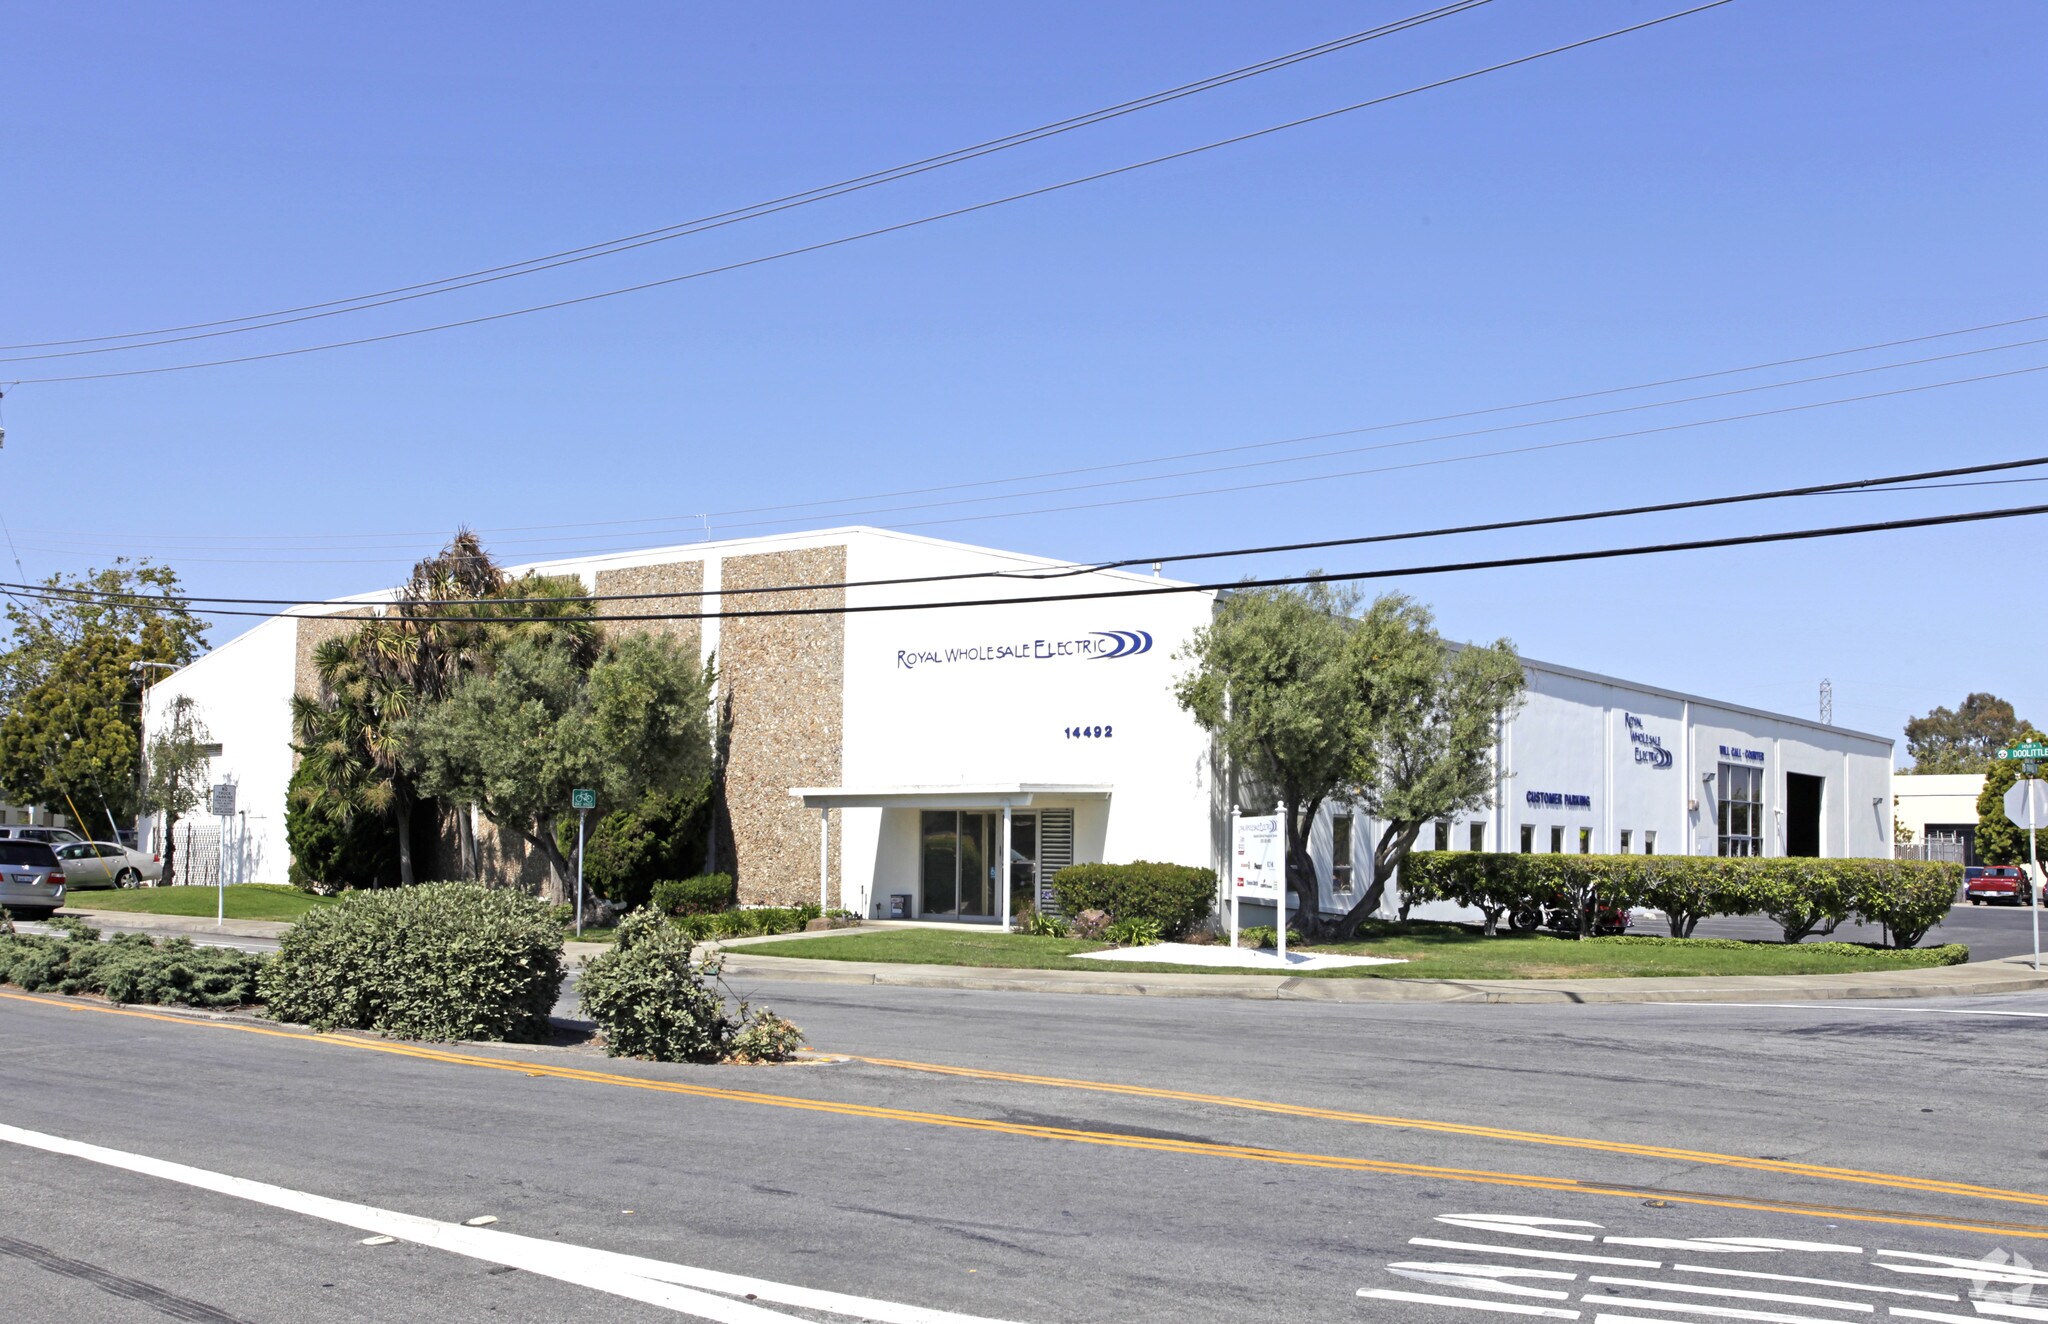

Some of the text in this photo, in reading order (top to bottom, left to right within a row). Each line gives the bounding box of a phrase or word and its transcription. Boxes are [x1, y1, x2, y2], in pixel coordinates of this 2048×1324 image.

[897, 638, 1107, 669] ROYAL WHOLESALE ELECTRIC
[1624, 712, 1643, 728] ROYAL
[1064, 725, 1114, 739] 14492
[1630, 730, 1661, 746] WHOLESALE
[2013, 748, 2048, 758] DOOLITTLE
[1526, 791, 1591, 807] CUSTOMER PARKING
